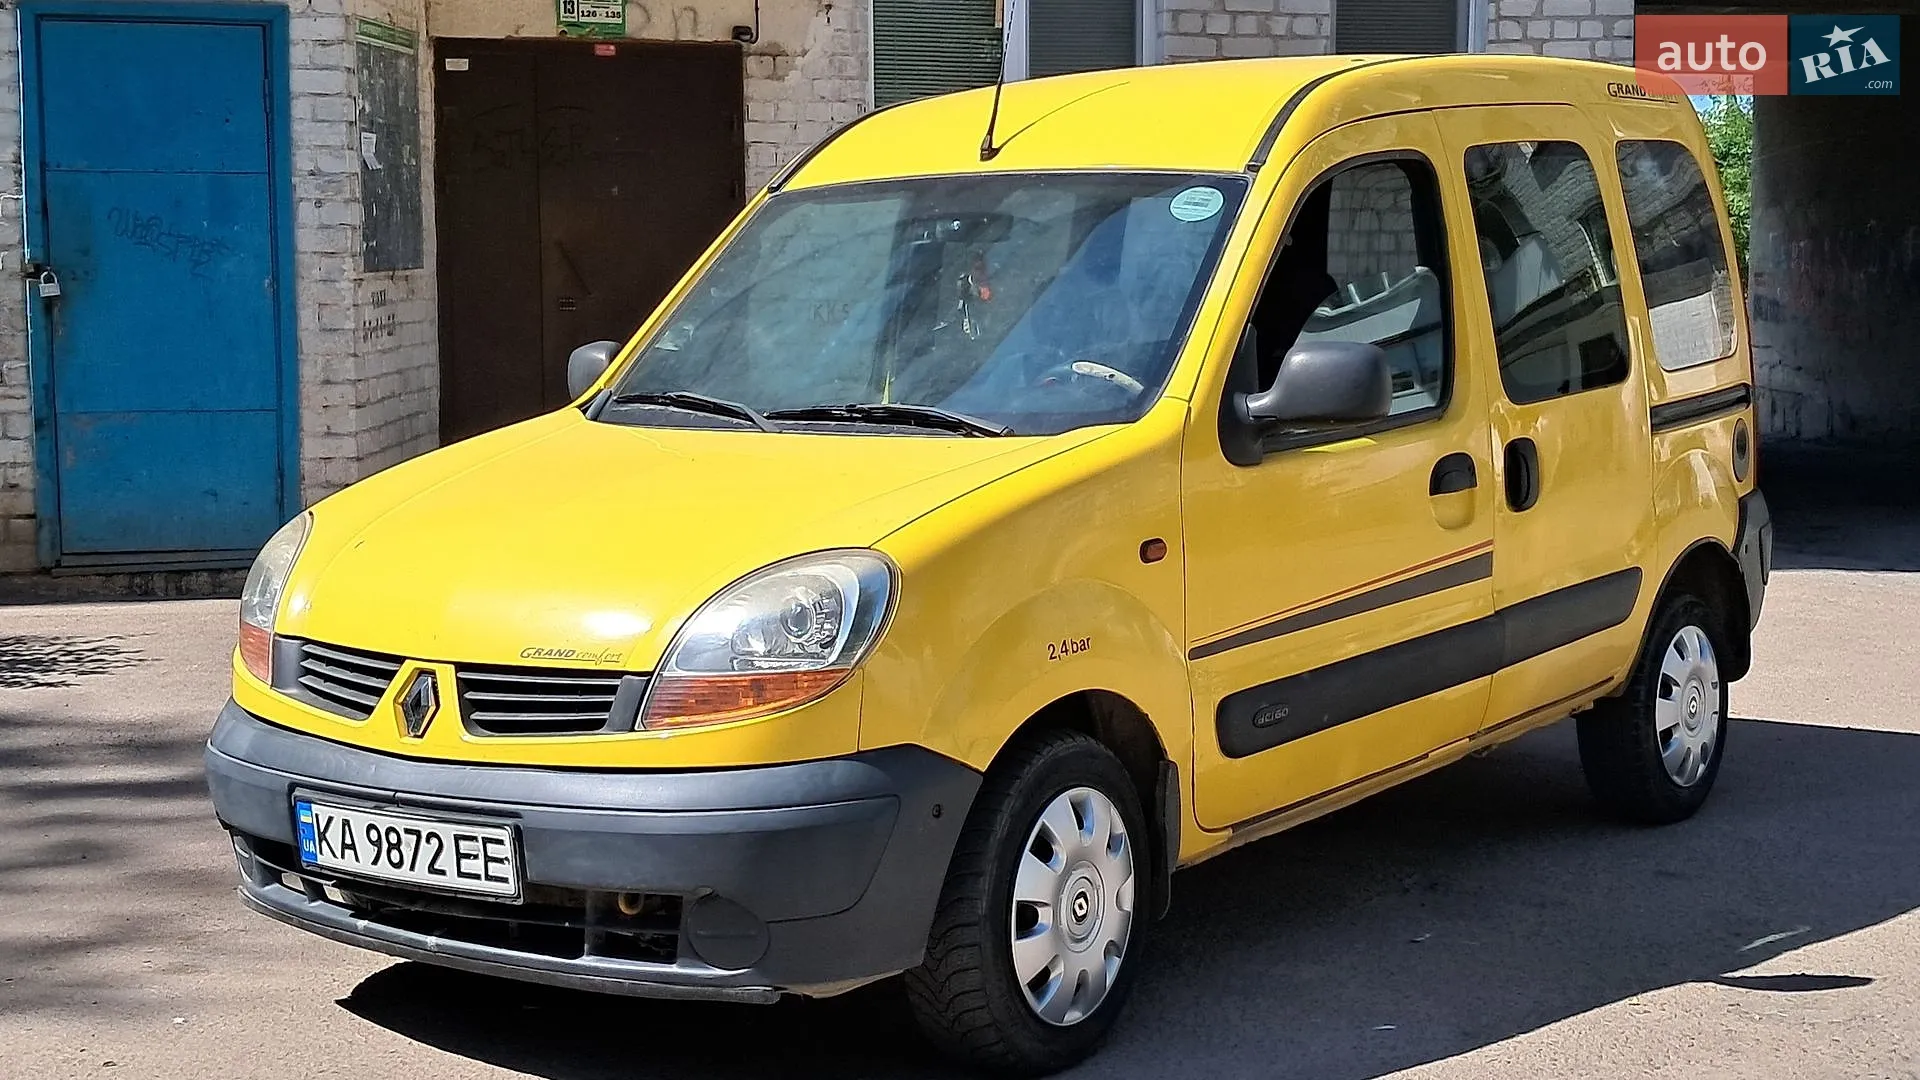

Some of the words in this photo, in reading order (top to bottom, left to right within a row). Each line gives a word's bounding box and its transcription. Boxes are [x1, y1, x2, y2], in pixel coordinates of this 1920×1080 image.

[563, 0, 575, 14] 13
[1607, 82, 1646, 98] GRAND
[520, 647, 576, 659] GRAND
[303, 838, 316, 854] UA
[314, 812, 360, 864] KA
[365, 823, 447, 877] 9872
[453, 833, 511, 885] EE
